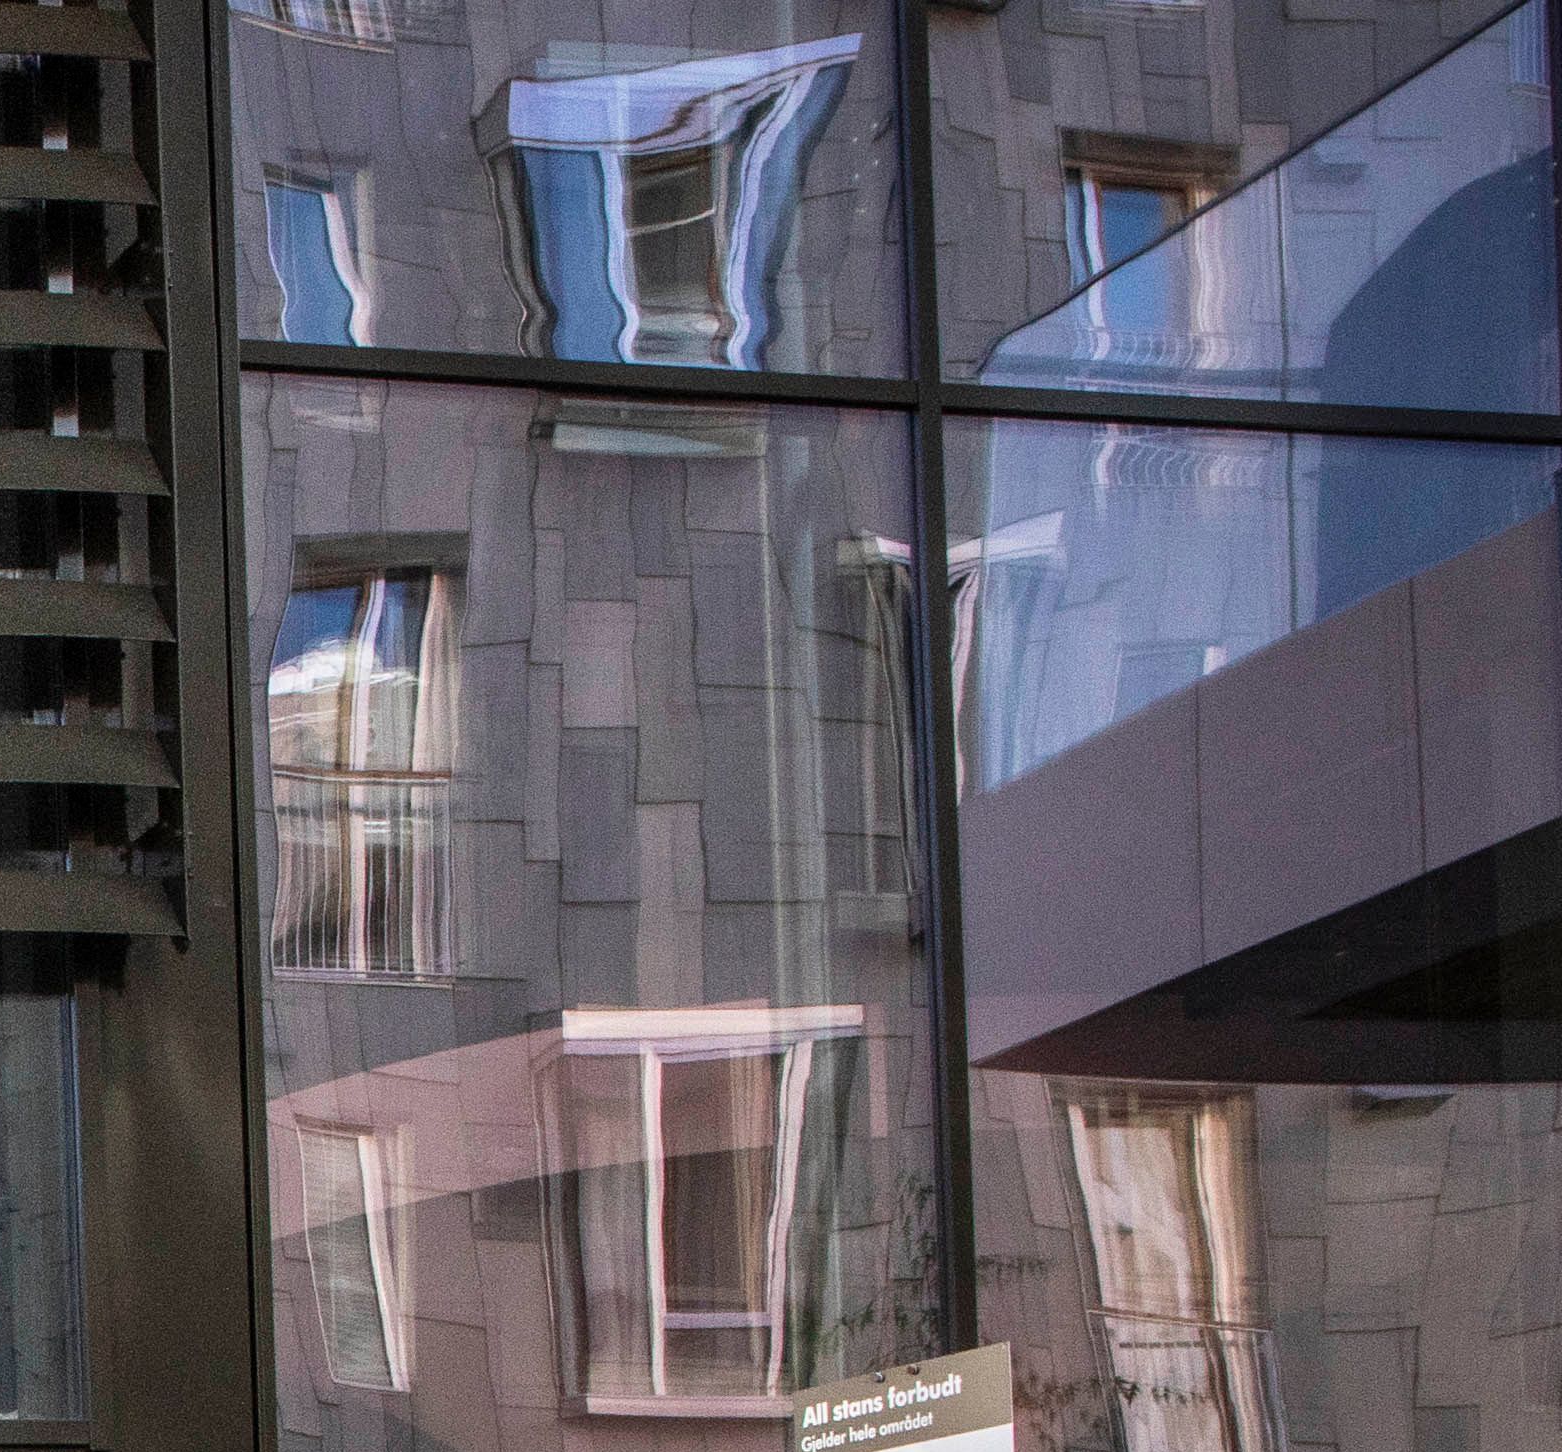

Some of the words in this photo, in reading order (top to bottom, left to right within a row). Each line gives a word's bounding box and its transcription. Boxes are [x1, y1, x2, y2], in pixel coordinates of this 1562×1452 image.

[802, 1401, 829, 1428] All
[832, 1394, 884, 1422] stans
[887, 1373, 962, 1409] forbudt
[849, 1424, 876, 1443] hele
[879, 1411, 934, 1436] området
